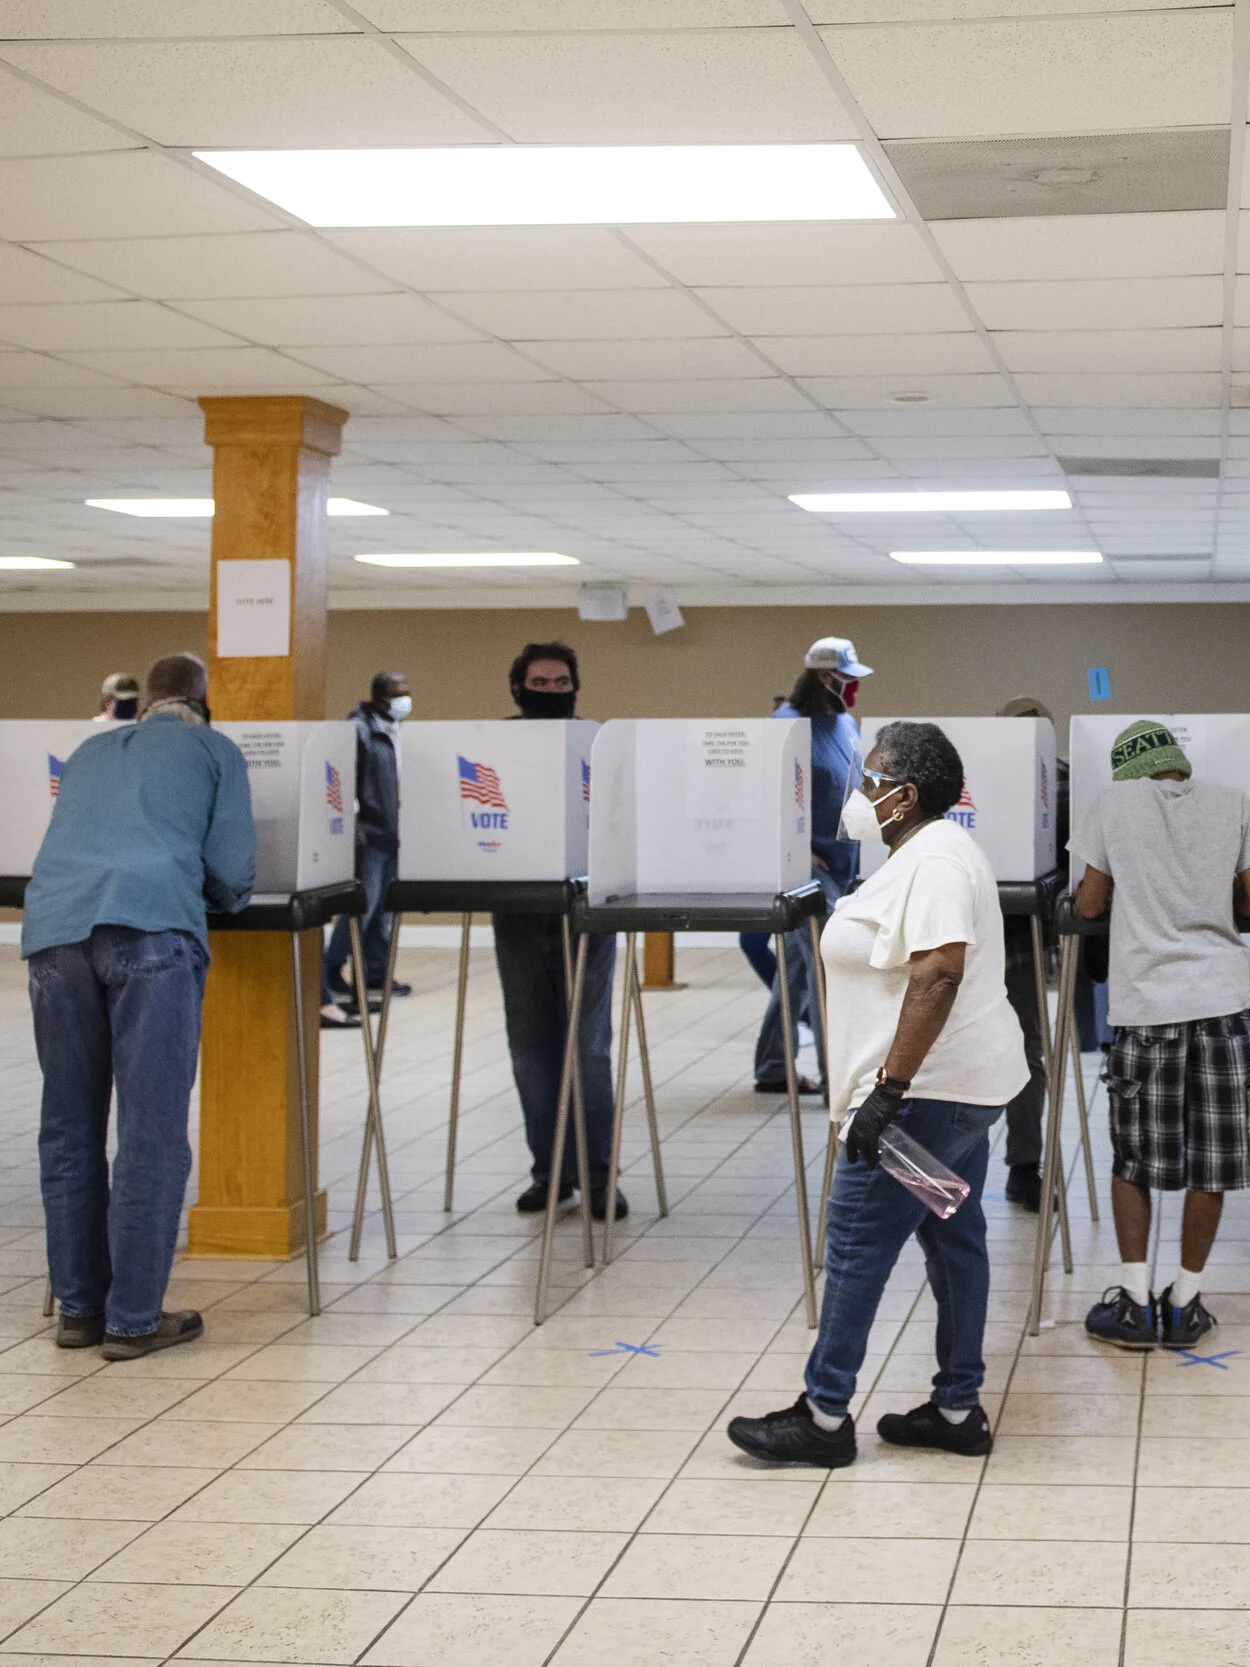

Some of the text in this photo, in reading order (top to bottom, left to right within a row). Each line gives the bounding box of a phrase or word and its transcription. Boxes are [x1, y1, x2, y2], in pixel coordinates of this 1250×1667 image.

[1112, 731, 1173, 766] SEATT
[704, 758, 726, 766] WITH
[470, 813, 508, 830] VOTE
[946, 811, 976, 828] OTE
